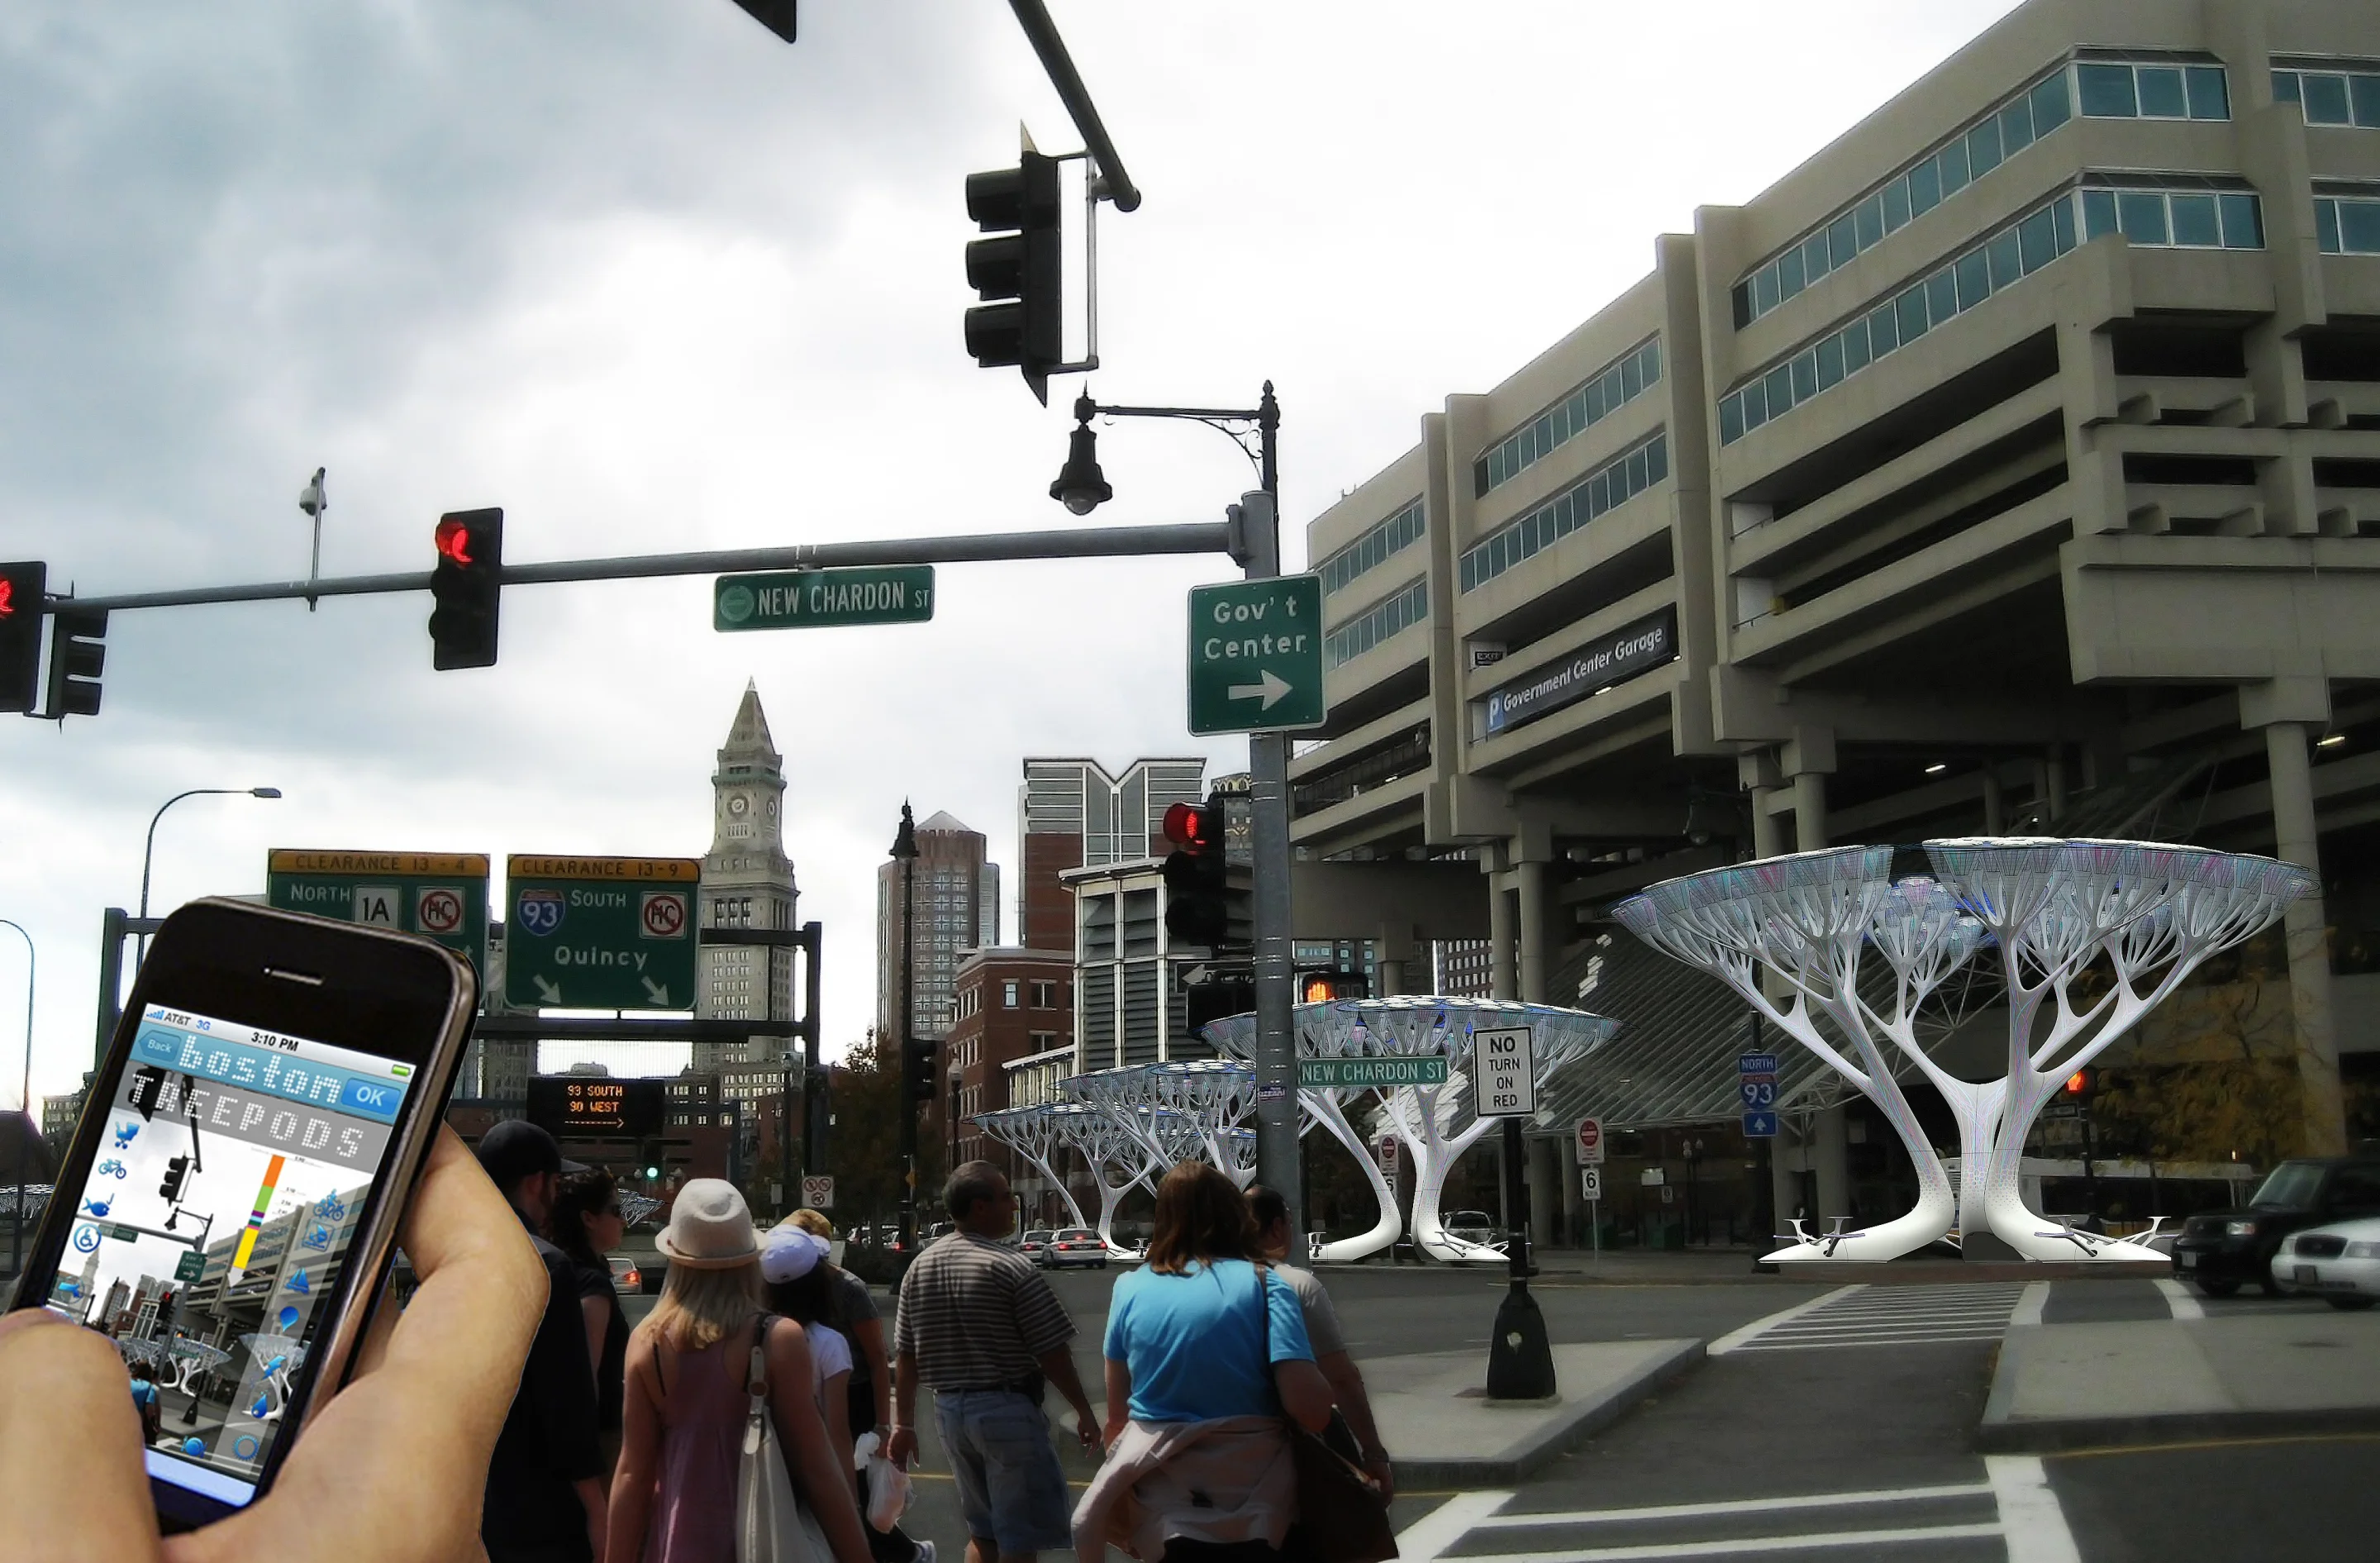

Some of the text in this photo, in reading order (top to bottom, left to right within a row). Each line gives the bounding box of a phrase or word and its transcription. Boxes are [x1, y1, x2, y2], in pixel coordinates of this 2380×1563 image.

[758, 586, 800, 616] NEW
[810, 581, 905, 613] CHARDON
[914, 589, 930, 608] ST
[1205, 633, 1307, 660] Center
[1489, 627, 1663, 727] P Government Center Garage
[296, 855, 399, 871] CLEARANCE
[522, 860, 626, 875] CLEARANCE
[291, 883, 351, 903] NORTH
[570, 889, 626, 908] SOUTH
[363, 897, 390, 922] 1A
[524, 901, 557, 927] 93
[555, 945, 648, 971] Quincy
[164, 1012, 299, 1052] AT&T 3G 3:10 PM
[147, 1039, 173, 1054] Back
[1490, 1036, 1516, 1053] NO
[178, 1034, 342, 1104] boston
[1302, 1061, 1444, 1082] NEW CHARDON ST
[1488, 1057, 1521, 1071] TURN
[1741, 1058, 1774, 1070] NORTH
[567, 1085, 623, 1097] 93 SOUTH
[1497, 1076, 1513, 1089] ON
[356, 1085, 384, 1107] OK
[1493, 1094, 1518, 1108] RED
[1744, 1083, 1773, 1104] 93
[131, 1073, 364, 1159] TREEPODS
[569, 1101, 620, 1113] 90 WEST
[1586, 1172, 1597, 1189] 6
